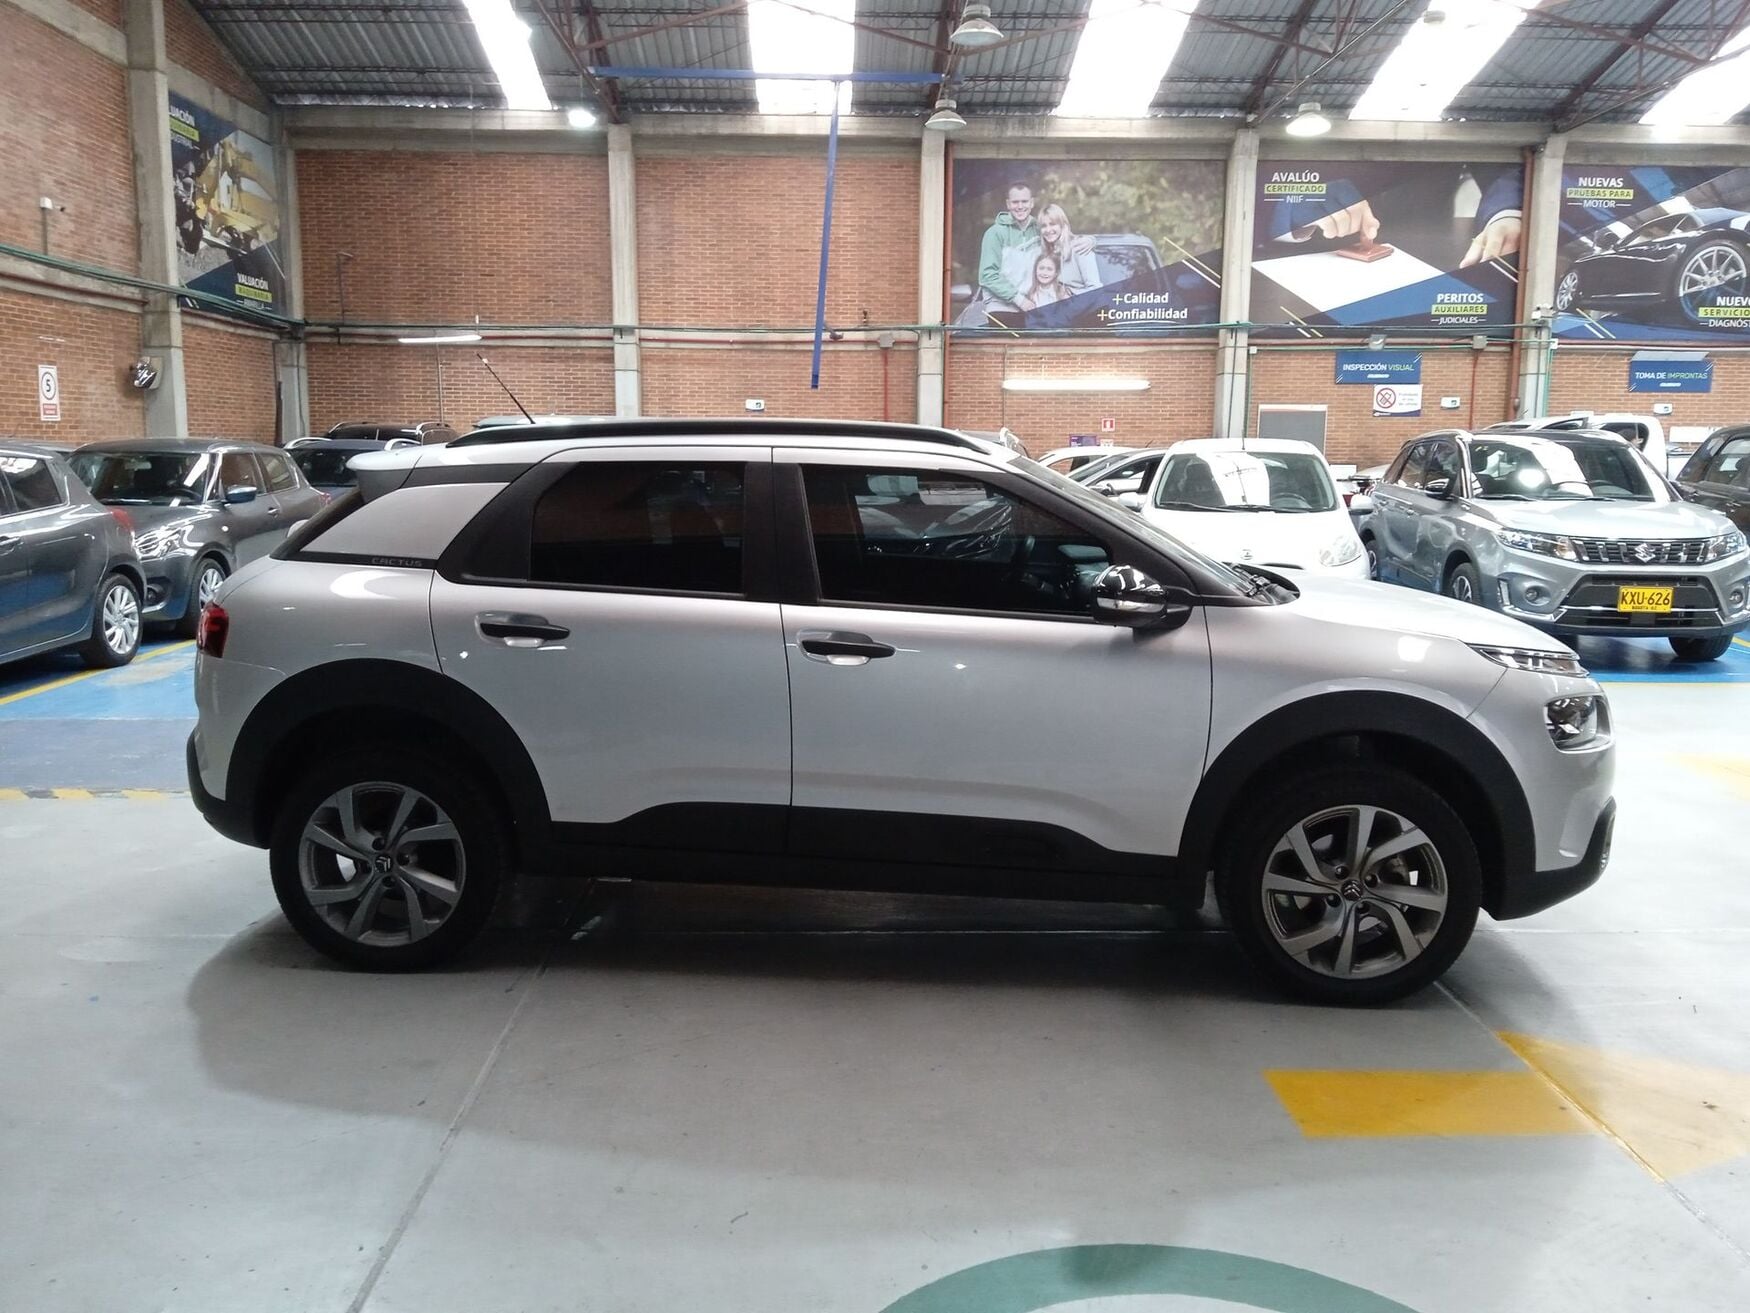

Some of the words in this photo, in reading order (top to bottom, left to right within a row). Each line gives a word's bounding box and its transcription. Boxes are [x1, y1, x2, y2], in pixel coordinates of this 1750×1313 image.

[1271, 169, 1320, 182] AVALÚO
[1578, 177, 1624, 187] NUEVAS
[1568, 189, 1607, 197] PRUEBAS
[1608, 190, 1632, 198] PARA
[1583, 200, 1616, 208] MOTOR
[236, 272, 269, 290] VALUACIÓN
[1437, 293, 1484, 303] PERITOS
[1716, 296, 1750, 306] NUEV
[1438, 316, 1479, 325] JUDICIALES
[1343, 363, 1387, 371] INSPECCIÓN
[45, 378, 52, 393] 5
[371, 557, 422, 567] CACTUS
[1621, 591, 1670, 605] KXU-626
